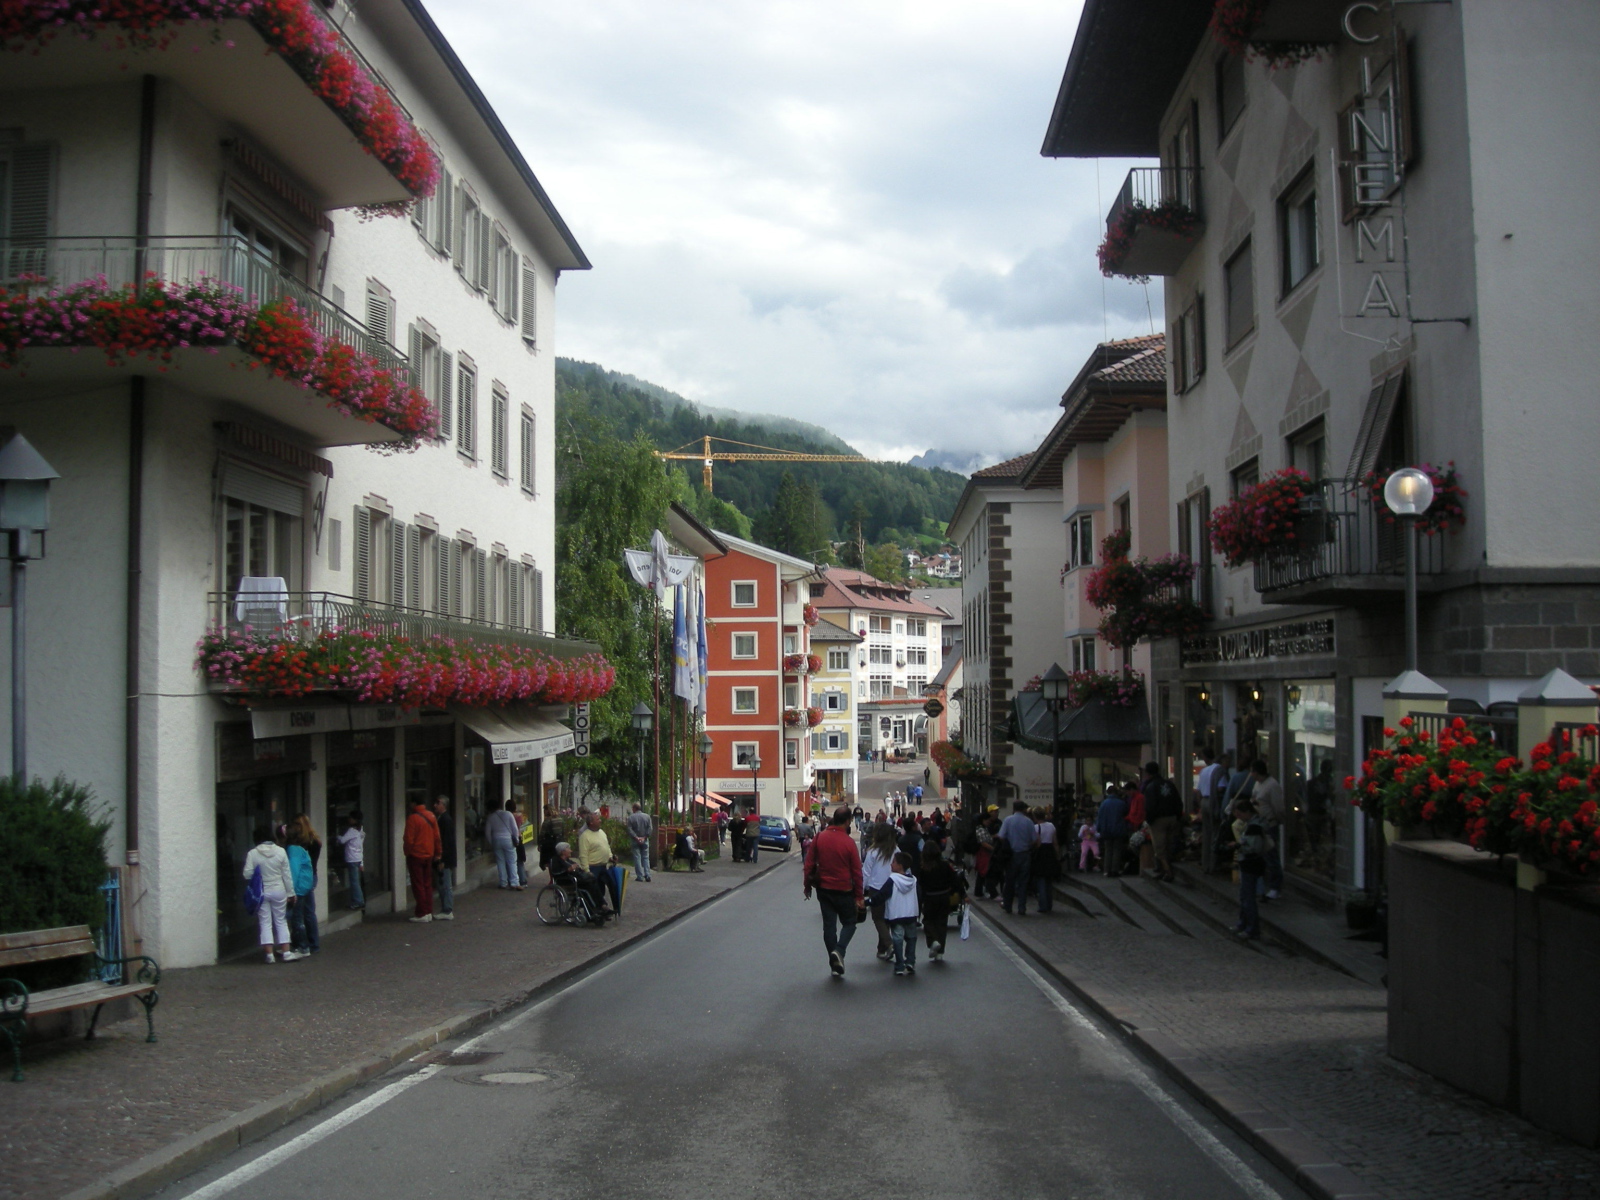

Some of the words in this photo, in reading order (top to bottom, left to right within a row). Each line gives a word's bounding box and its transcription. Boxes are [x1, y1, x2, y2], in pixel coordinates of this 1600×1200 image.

[1344, 2, 1400, 318] CINEMA
[290, 711, 315, 727] DENIM
[576, 703, 588, 756] FOTO
